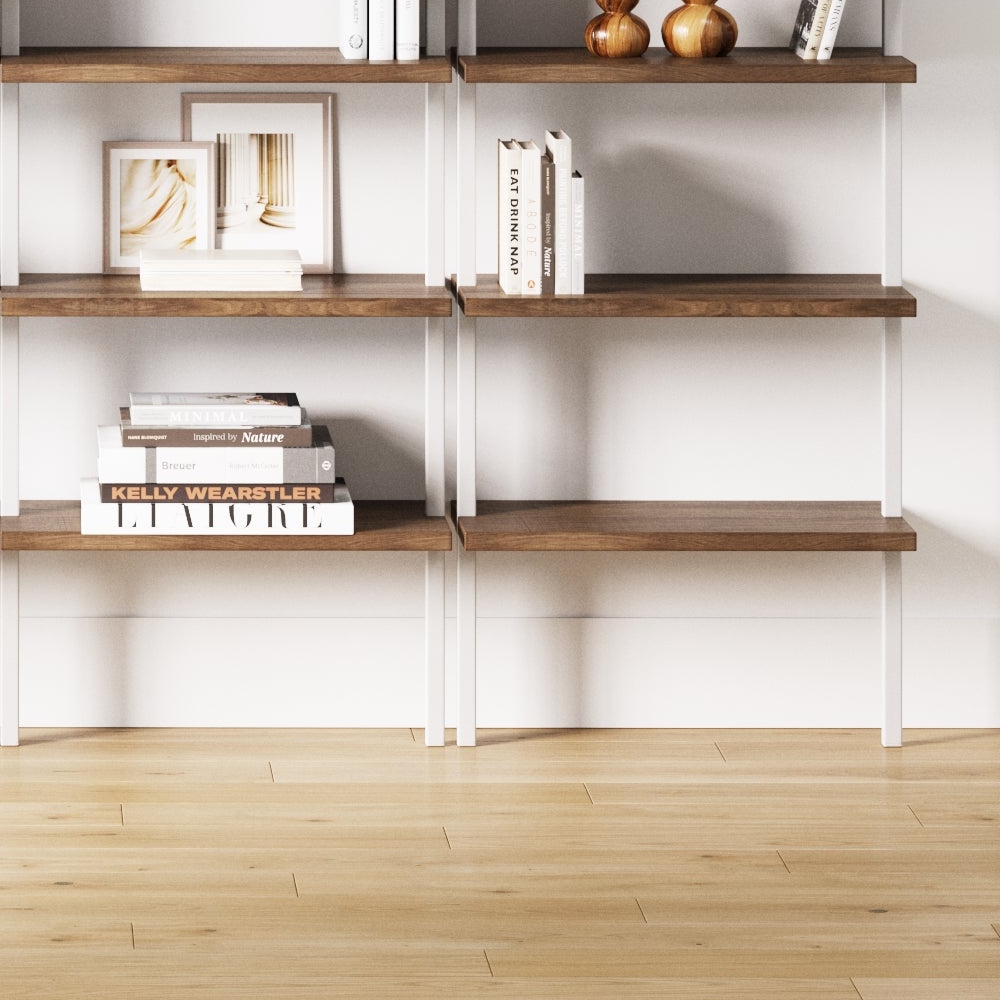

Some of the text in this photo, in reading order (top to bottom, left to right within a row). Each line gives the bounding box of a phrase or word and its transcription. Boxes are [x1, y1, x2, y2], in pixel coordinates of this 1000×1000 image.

[510, 168, 519, 276] EAT DRINK NAP
[543, 246, 552, 278] Nature
[168, 410, 249, 423] MINIMAL
[193, 432, 285, 443] Inspired by Nature
[161, 461, 197, 471] Breuer
[110, 486, 322, 501] KELLY WEARSTLER
